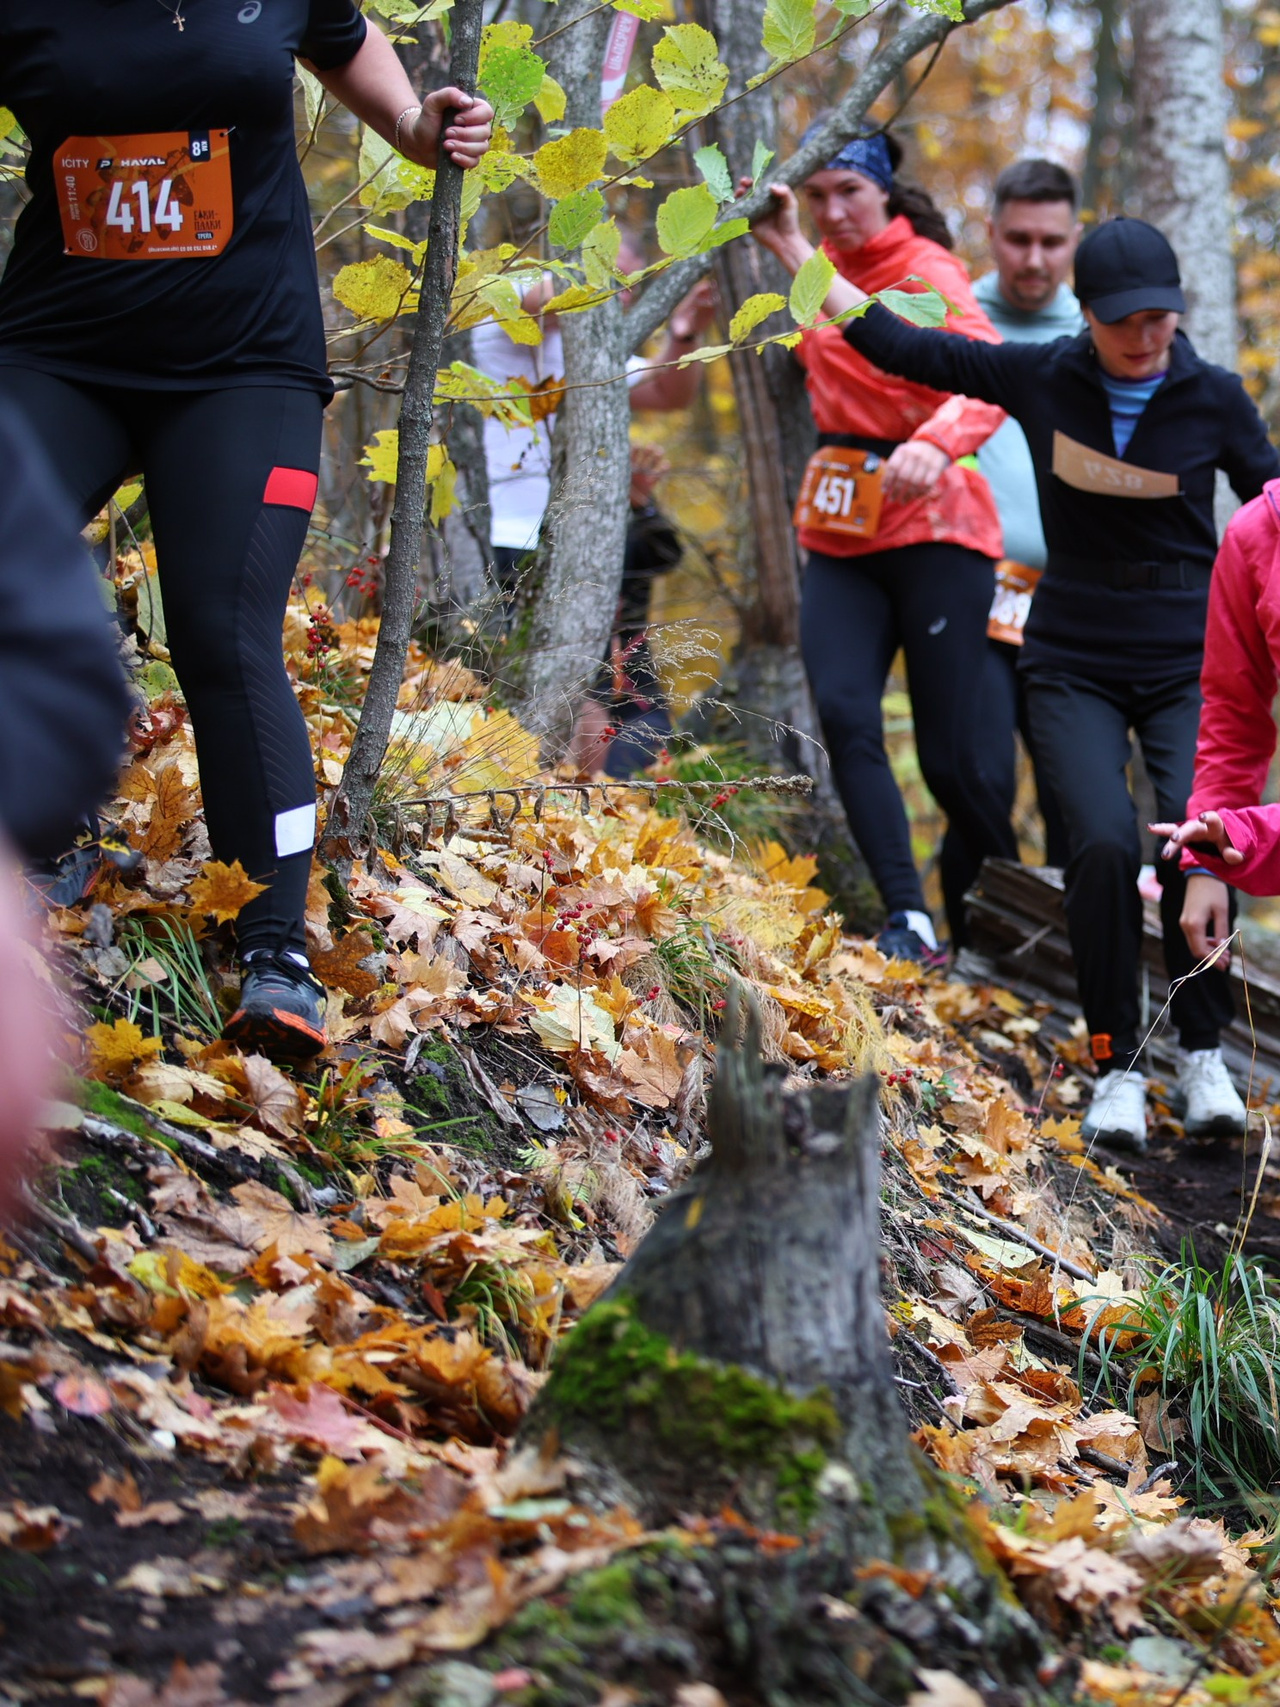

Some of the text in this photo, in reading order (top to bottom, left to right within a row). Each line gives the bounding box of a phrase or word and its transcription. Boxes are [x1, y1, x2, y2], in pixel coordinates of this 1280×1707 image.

[192, 141, 202, 156] 8
[61, 158, 90, 168] ICITY
[120, 157, 166, 167] HAVAL
[64, 176, 77, 202] 11:40
[106, 179, 184, 234] 414
[812, 475, 856, 517] 451
